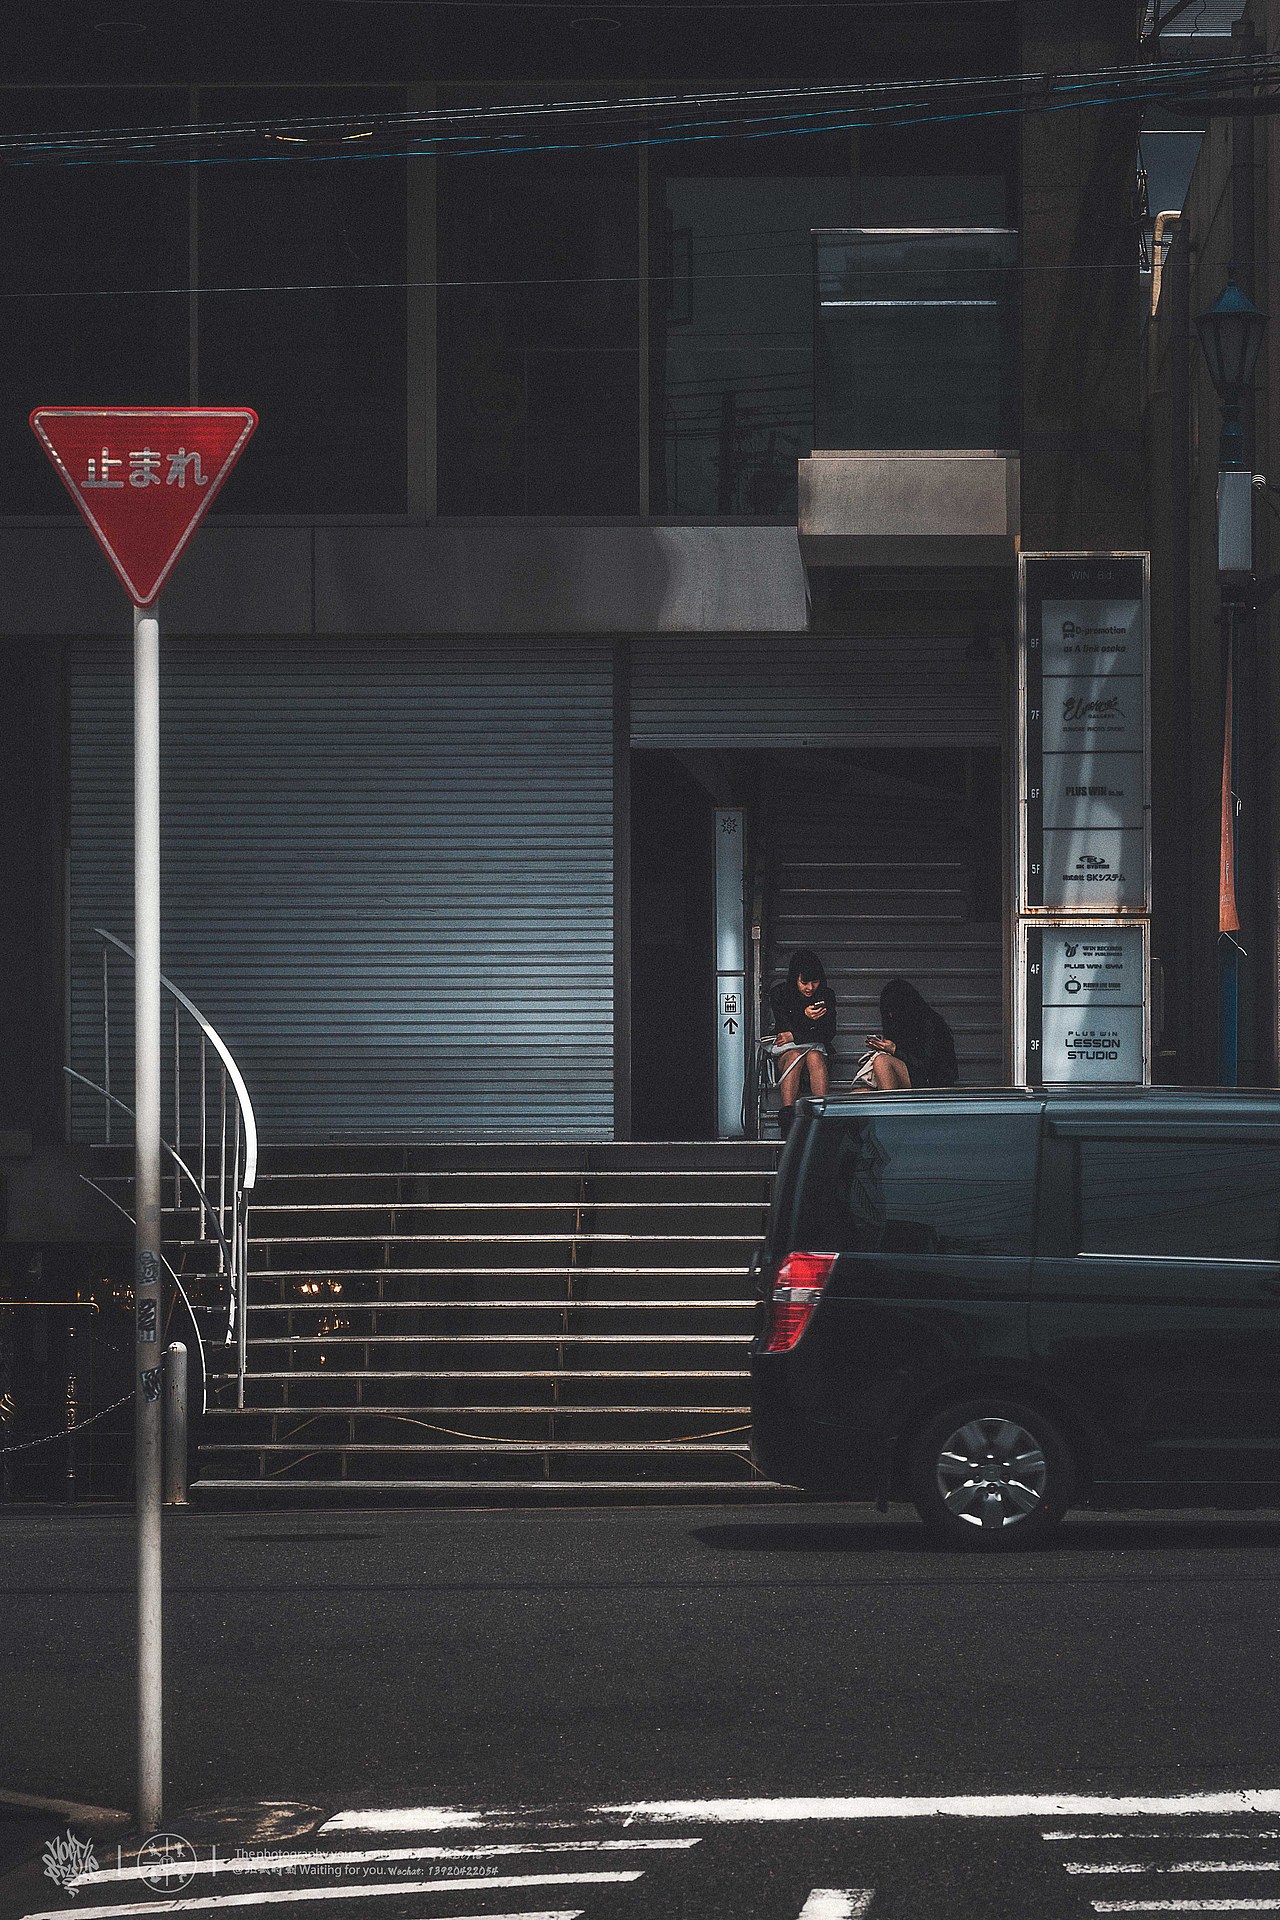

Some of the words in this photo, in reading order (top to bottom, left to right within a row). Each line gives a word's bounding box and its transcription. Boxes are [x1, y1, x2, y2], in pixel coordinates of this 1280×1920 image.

[81, 446, 209, 488] 止まれ
[1031, 638, 1039, 648] 8F
[1031, 710, 1040, 720] 7F
[1031, 788, 1040, 799] 6F
[1066, 787, 1087, 796] PLUS
[1031, 864, 1040, 874] 5F
[1030, 963, 1040, 974] 4F
[1030, 1039, 1040, 1050] 3F
[1065, 1039, 1120, 1048] LESSON
[1067, 1051, 1118, 1060] STUDIO
